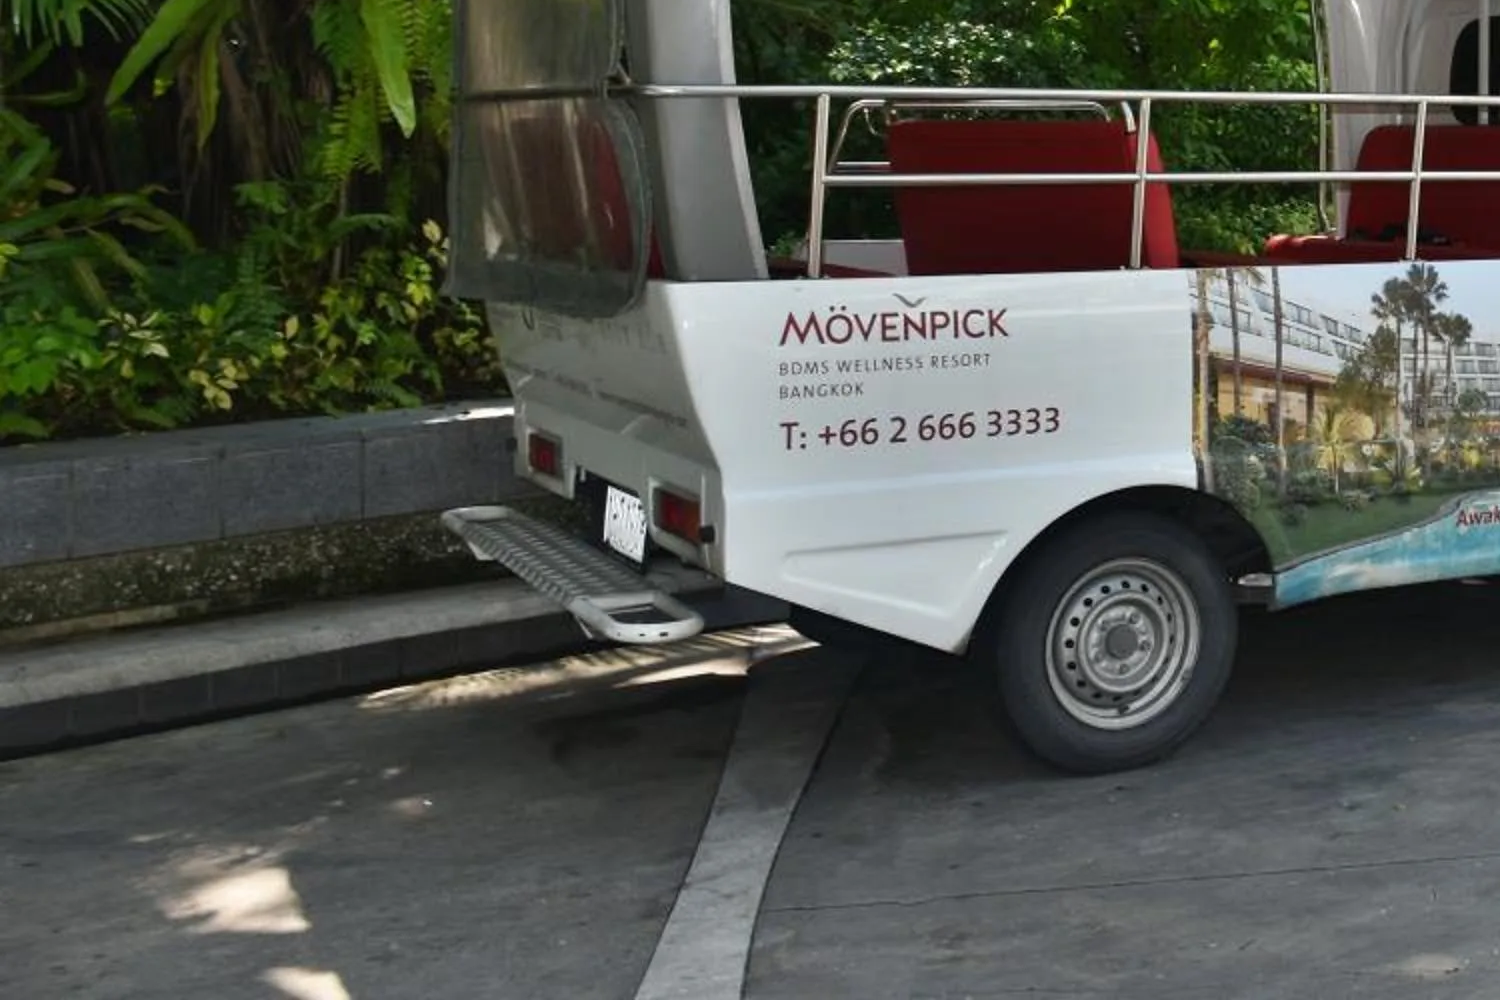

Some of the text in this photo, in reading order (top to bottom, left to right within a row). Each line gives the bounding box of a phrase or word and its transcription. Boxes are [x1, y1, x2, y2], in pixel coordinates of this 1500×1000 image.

[779, 305, 1009, 346] MÖVENPICK
[779, 353, 991, 376] BDMS WELLNESS RESORT
[779, 382, 864, 400] BANGKOK
[780, 407, 1060, 450] T: +66 2 666 3333
